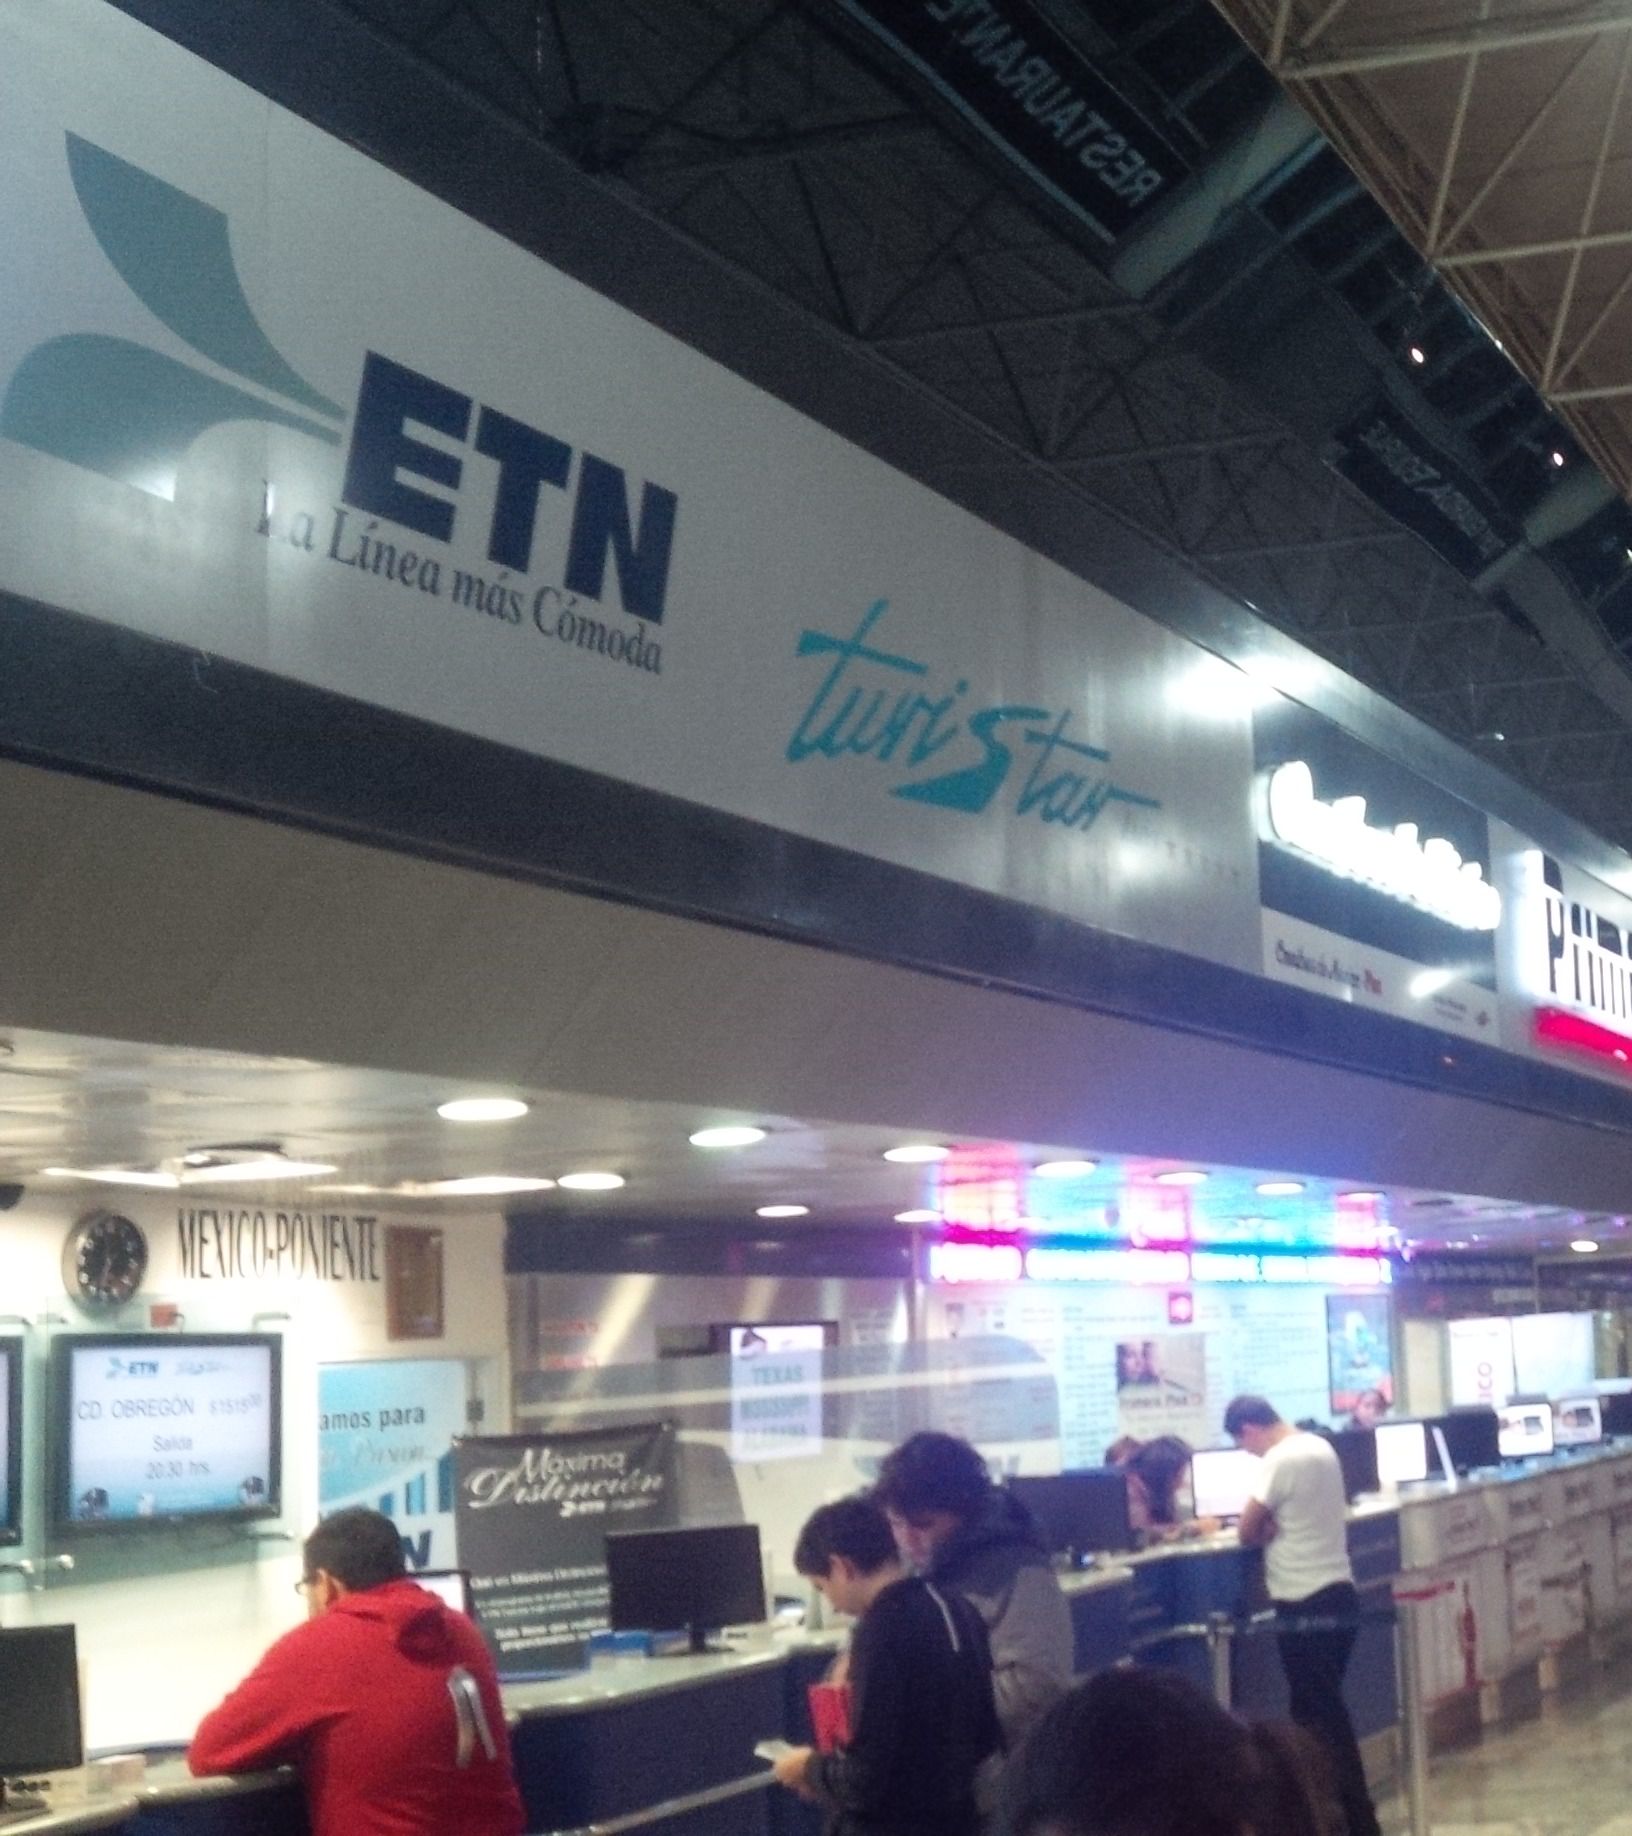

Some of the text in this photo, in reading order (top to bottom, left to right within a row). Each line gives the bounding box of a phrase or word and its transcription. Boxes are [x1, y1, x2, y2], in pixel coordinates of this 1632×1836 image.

[341, 349, 678, 625] ETN
[328, 506, 441, 596] Línea
[451, 572, 523, 626] más
[533, 583, 662, 675] Cómoda
[379, 1406, 425, 1432] para
